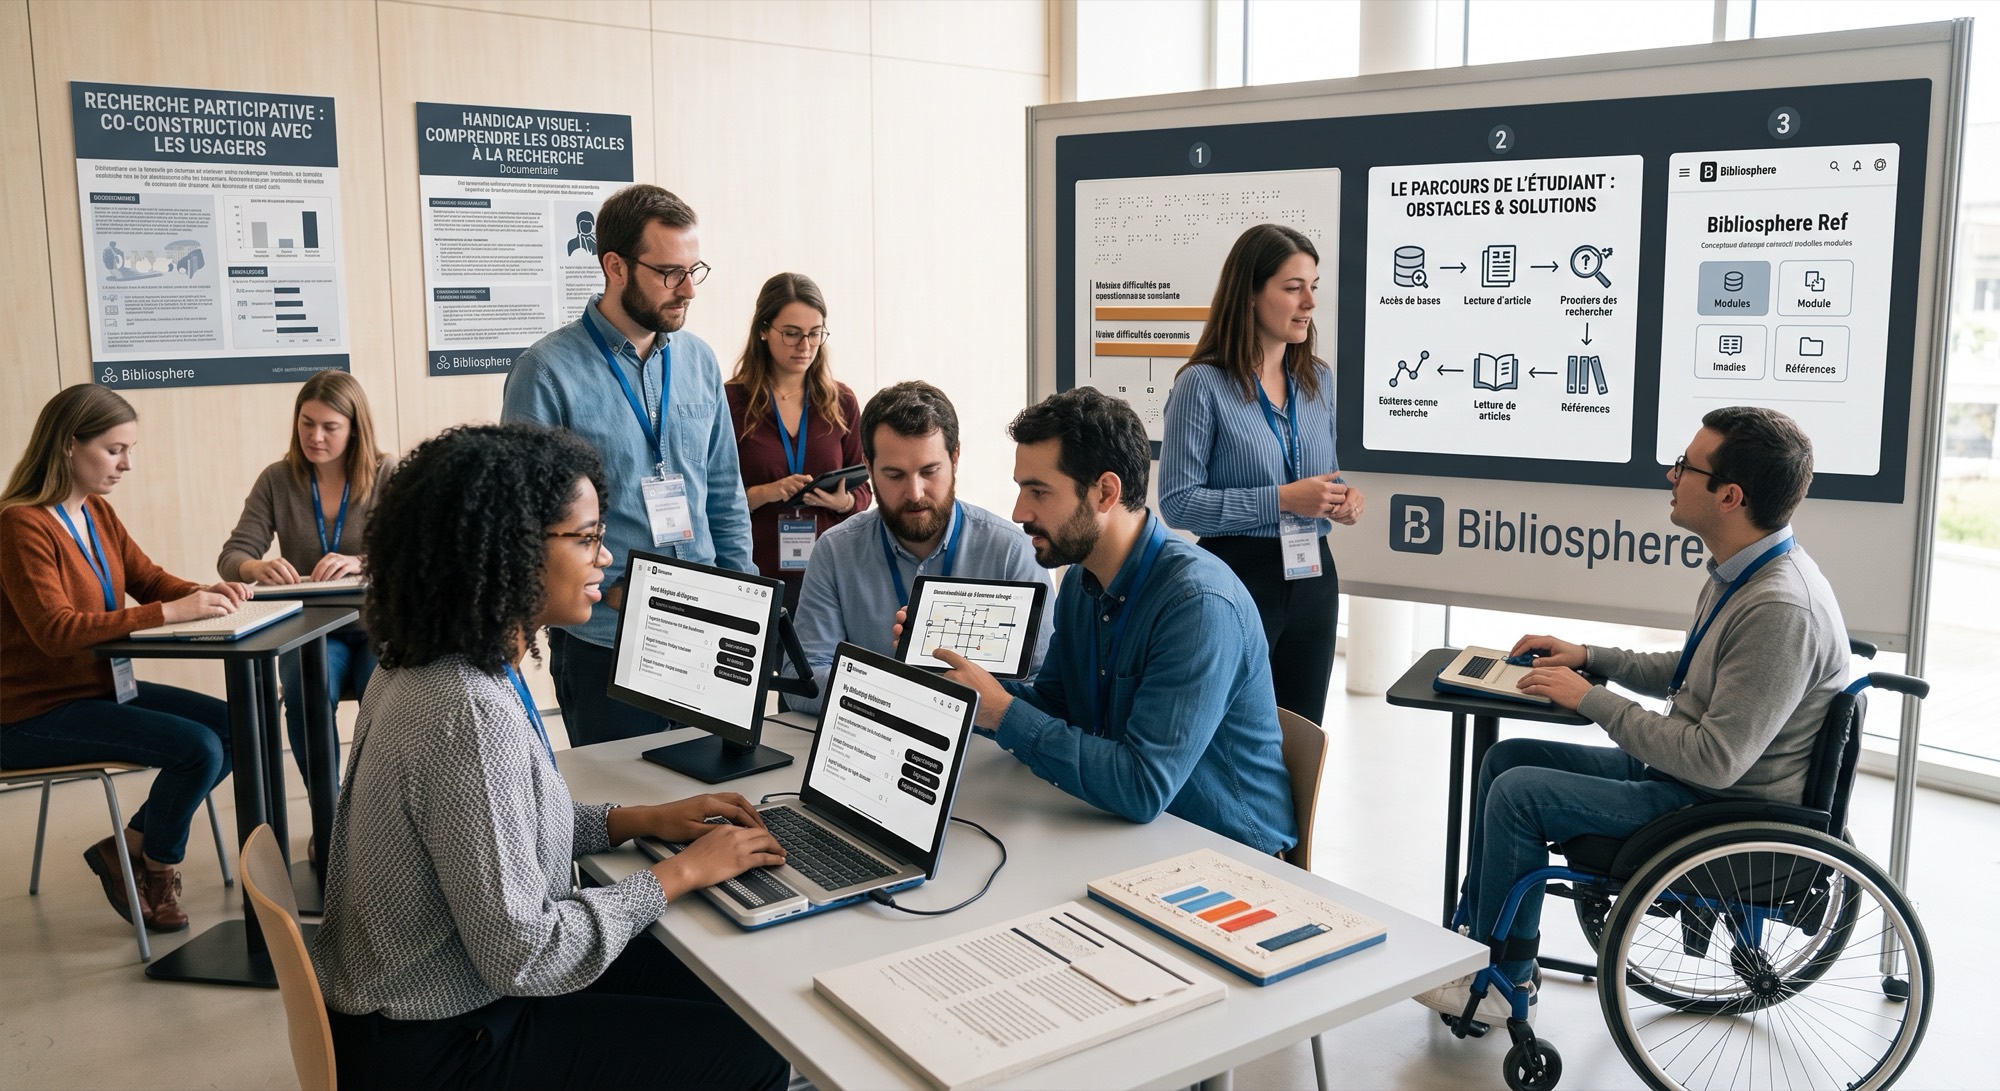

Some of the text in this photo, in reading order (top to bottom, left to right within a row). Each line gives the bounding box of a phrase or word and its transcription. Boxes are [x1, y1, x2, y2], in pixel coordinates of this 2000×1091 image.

[84, 92, 325, 121] RECHERCHE PARTICIPATIVE :
[100, 113, 313, 139] CO-CONSTRUCTION AVEC
[462, 112, 590, 133] HANDICAP VISUEL :
[1776, 113, 1790, 134] 3
[425, 128, 625, 151] COMPRENDRE LES OBSTACLES
[1495, 130, 1507, 149] 2
[154, 136, 267, 157] LES USAGERS
[472, 144, 584, 165] À LA RECHERCHE
[1195, 146, 1203, 164] 1
[500, 164, 559, 176] Documentaire
[1720, 164, 1777, 177] Bibliosphere
[1391, 172, 1615, 197] LE PARCOURS DE L'ÉTUDIANT :
[1406, 196, 1597, 217] OBSTACLES & SOLUTIONS
[1707, 212, 1848, 236] Bibliosphere Ref
[1823, 239, 1853, 247] modules
[1122, 281, 1157, 289] difficultés
[1379, 295, 1441, 305] Accès de bases
[1463, 295, 1531, 305] Lecture d'article
[1602, 295, 1618, 305] des
[1714, 298, 1751, 308] Modules
[1797, 298, 1831, 308] Module
[1565, 306, 1613, 317] rechercher
[1116, 330, 1152, 339] difficultés
[453, 356, 512, 368] Bibliosphere
[1713, 362, 1746, 372] Imadies
[121, 367, 195, 382] Bibliosphere
[1785, 363, 1836, 375] Références
[1474, 400, 1516, 410] Letture de
[1561, 402, 1610, 414] Références
[1389, 407, 1428, 418] recherche
[1479, 411, 1511, 421] articles
[1458, 507, 1704, 570] Bibliosphere
